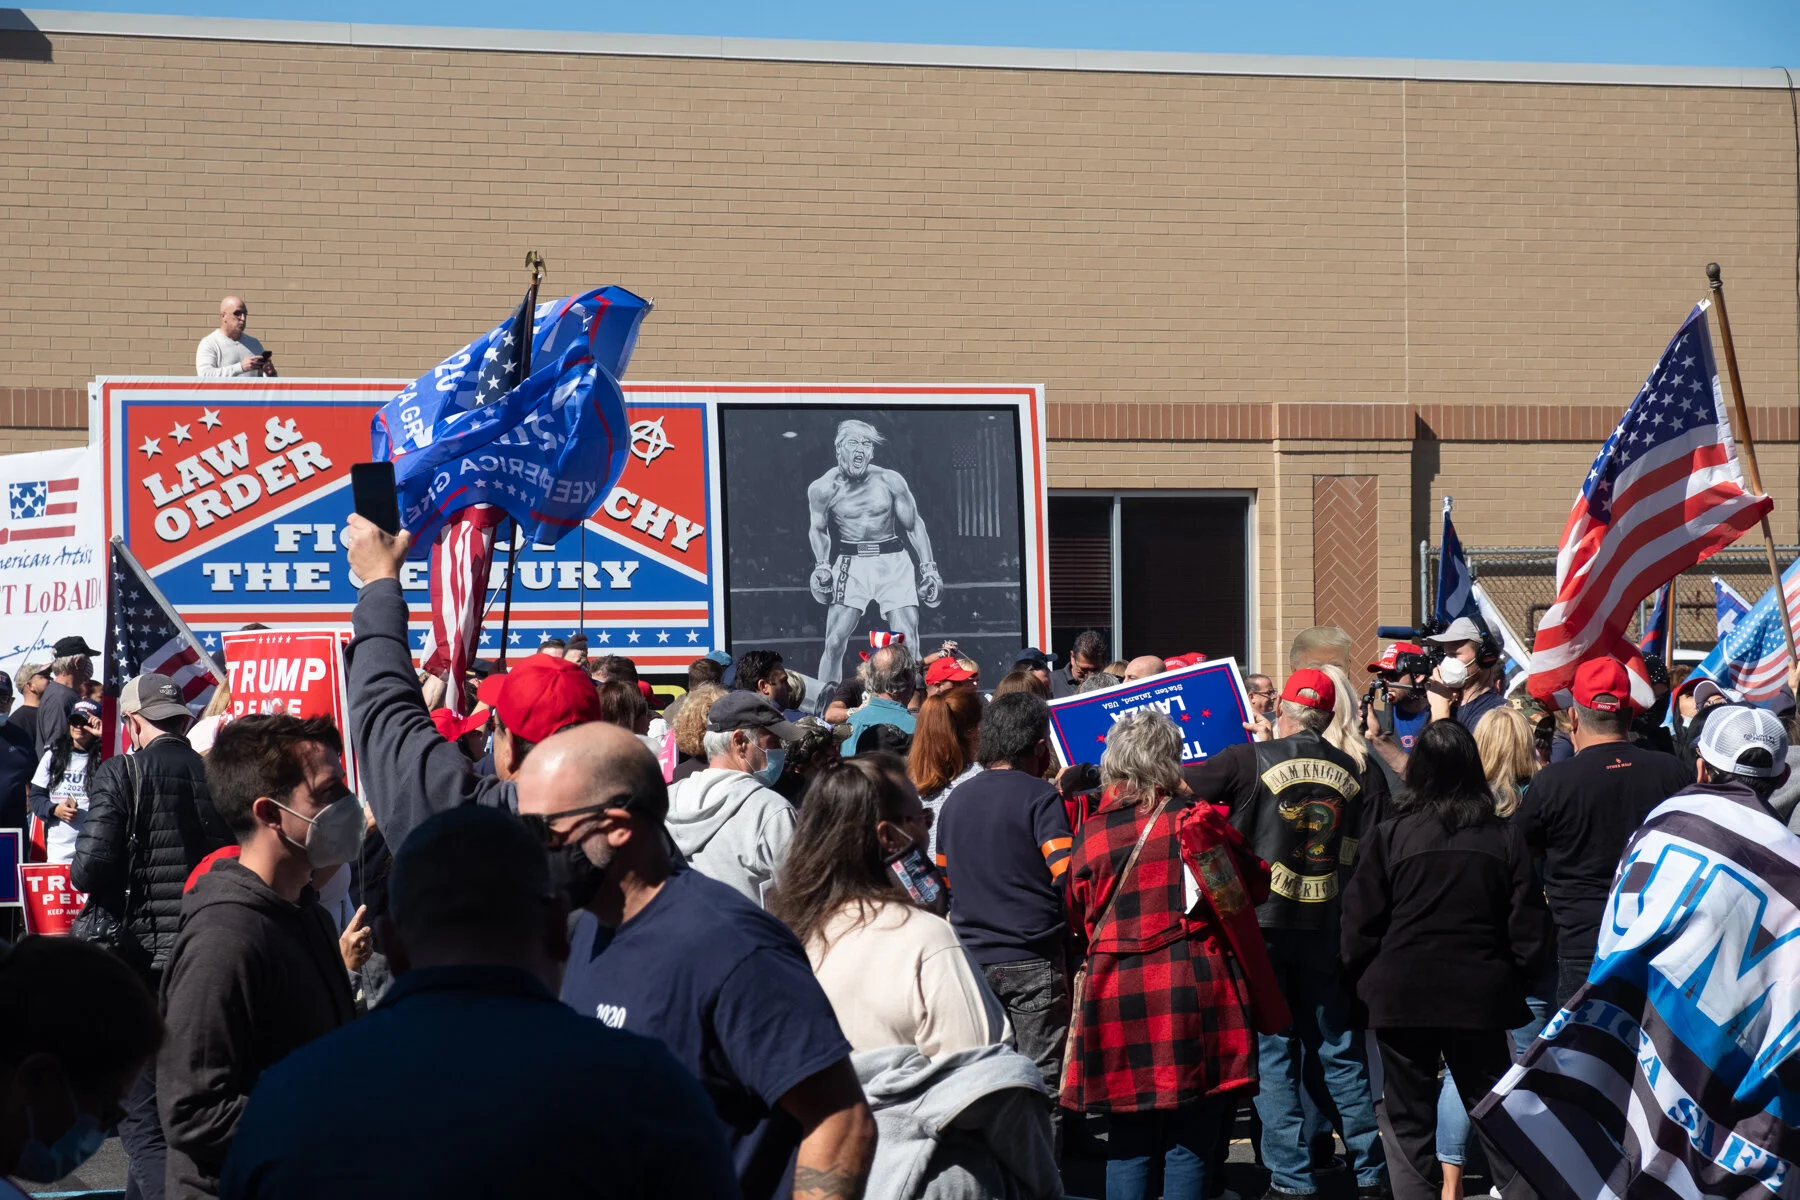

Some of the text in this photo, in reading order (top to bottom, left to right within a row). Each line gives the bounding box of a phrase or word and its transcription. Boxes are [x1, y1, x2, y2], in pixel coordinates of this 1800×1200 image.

[142, 416, 303, 509] LAW &
[154, 441, 333, 542] ORDER
[603, 486, 704, 551] CHY
[202, 562, 331, 592] THE
[837, 557, 850, 602] TRUMP
[0, 583, 18, 615] T
[226, 657, 327, 694] TRUMP
[1101, 683, 1184, 710] Staten Island, USA
[1271, 763, 1356, 796] NAM KNIGHTS
[47, 908, 65, 916] KEEP
[1667, 1097, 1791, 1193] SAFE
